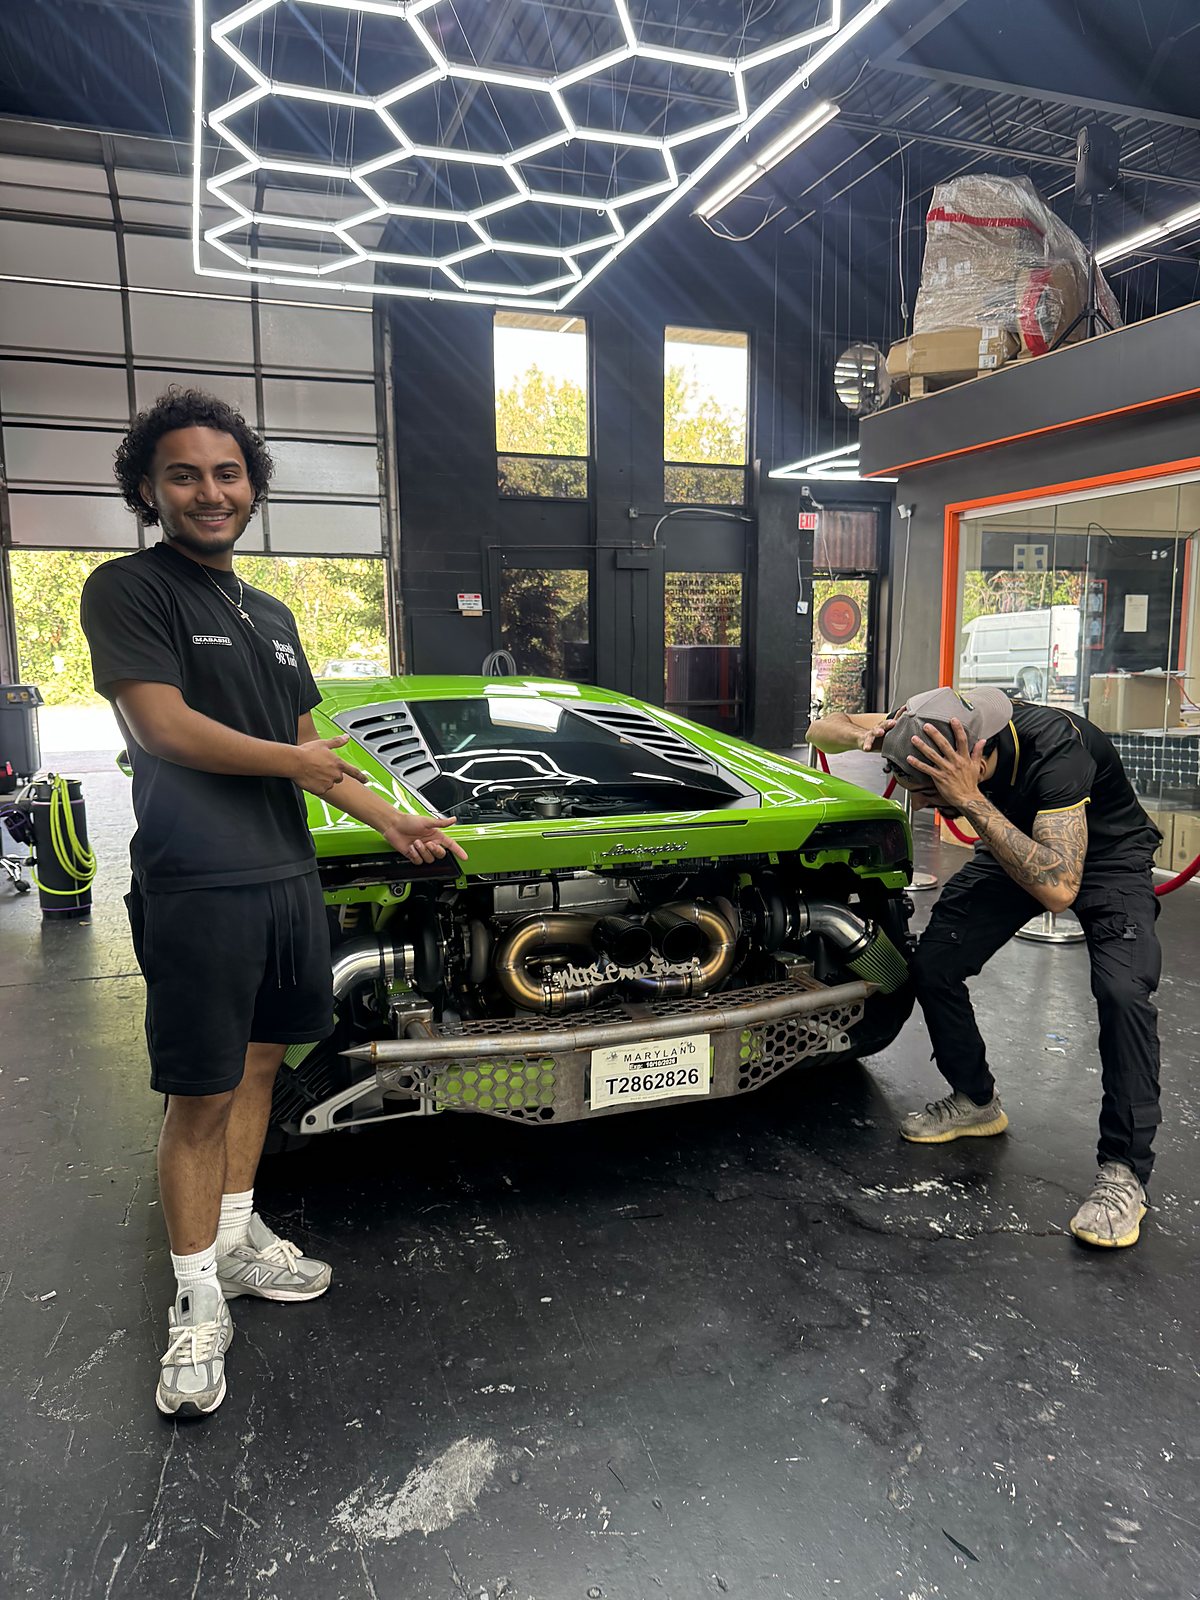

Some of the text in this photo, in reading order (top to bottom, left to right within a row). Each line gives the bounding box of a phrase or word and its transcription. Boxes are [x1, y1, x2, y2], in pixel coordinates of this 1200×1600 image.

[800, 513, 816, 528] EXIT
[275, 651, 287, 665] 98
[624, 1045, 696, 1062] MARYLAND
[606, 1068, 699, 1095] T2862826
